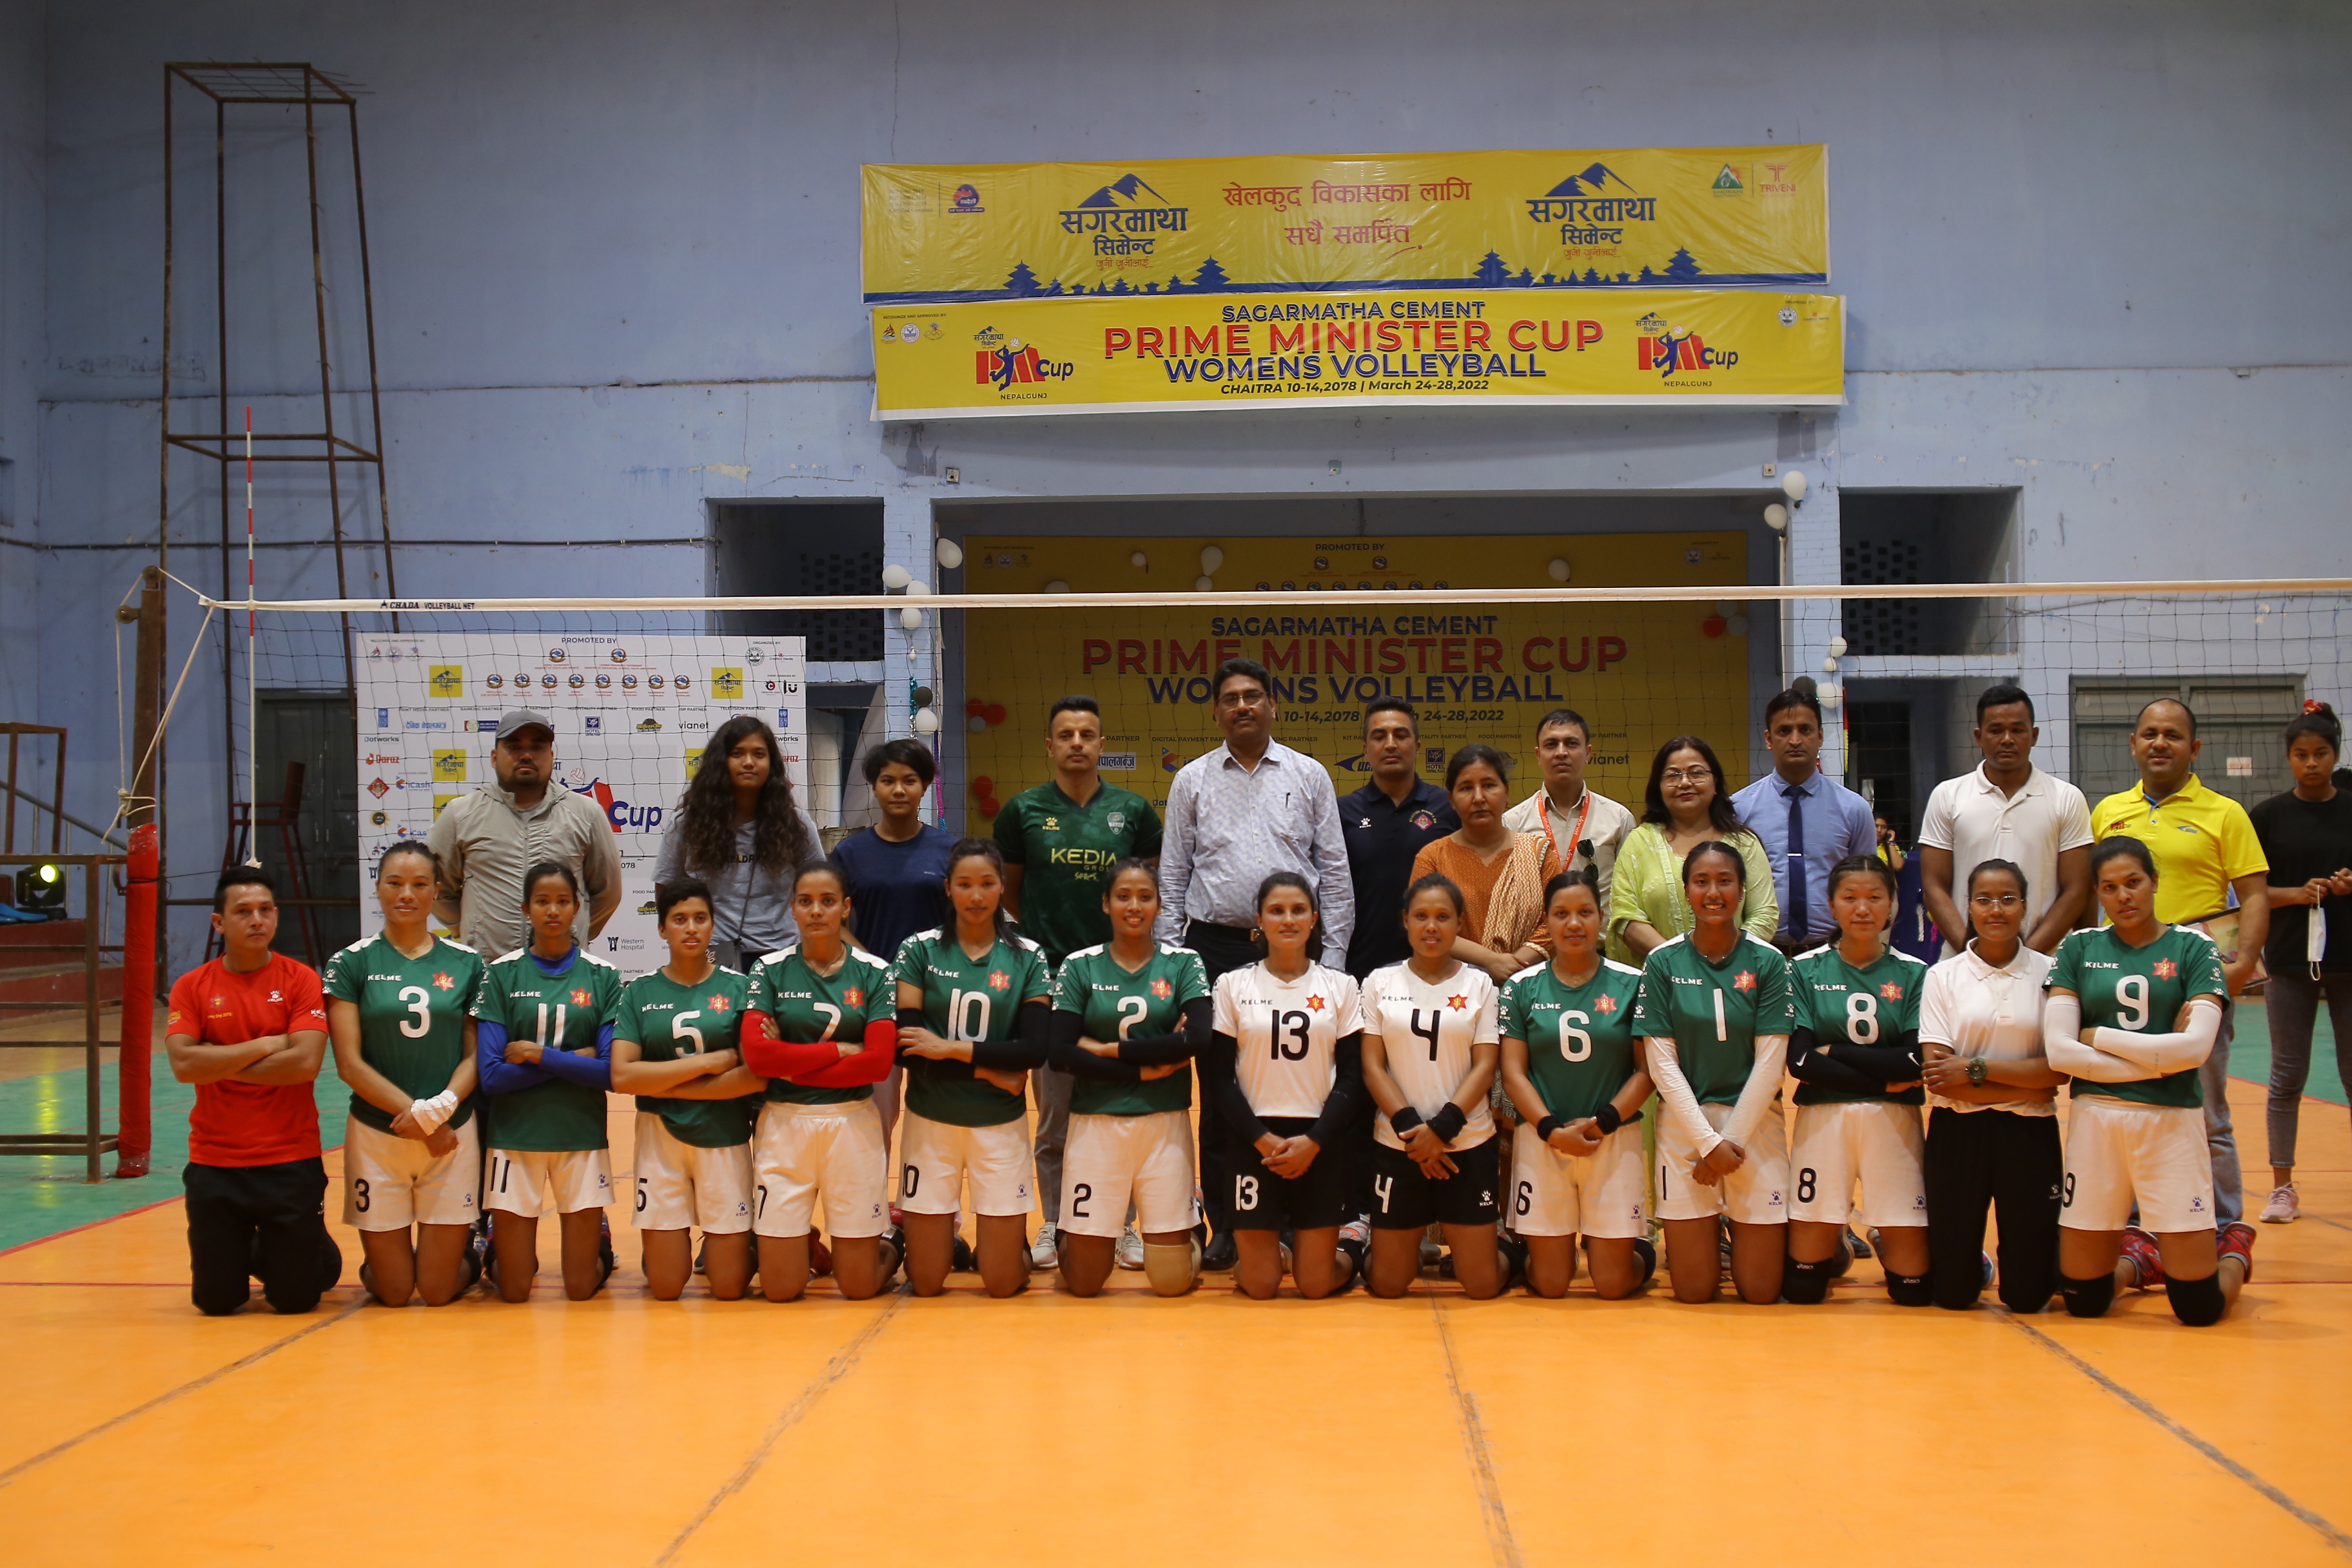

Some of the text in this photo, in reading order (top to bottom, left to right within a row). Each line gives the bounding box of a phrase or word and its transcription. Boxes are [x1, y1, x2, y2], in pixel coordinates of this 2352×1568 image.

[1222, 177, 1472, 211] खेलकुद विकासका लागि
[1526, 198, 1656, 222] सगरमाथा
[1059, 208, 1188, 233] सगरमाथा
[1332, 218, 1412, 244] समर्पित
[1561, 223, 1623, 244] सिमेन्ट
[1093, 233, 1155, 255] सिमेन्ट
[1222, 301, 1485, 322] SAGARMATHA CEMENT
[1104, 319, 1603, 359] PRIME MINISTER CUP
[1035, 359, 1073, 381] Cup
[1163, 353, 1547, 382] WOMENS VOLLEYBALL
[1700, 348, 1738, 370] Cup
[1220, 380, 1489, 395] CHAITRA 10-14,2078 March 24-28,2022
[1211, 615, 1498, 636] SAGARMATHA CEMENT
[1083, 636, 1627, 674] PRIME MINISTER CUP
[1146, 675, 1563, 703] WONS VOLLEYBALL
[678, 721, 709, 729] vianet
[1284, 711, 1359, 722] 10-14,2078
[1424, 710, 1504, 721] 24-28,2022
[1588, 753, 1629, 764] vianet
[609, 801, 662, 832] Cup
[1051, 848, 1117, 866] KEDIA
[927, 965, 959, 979] KELME
[398, 986, 430, 1038] 3
[642, 1003, 674, 1012] KELME
[947, 988, 991, 1043] 10
[1117, 995, 1148, 1041] 2
[1713, 988, 1727, 1041] 1
[1847, 992, 1879, 1044] 8
[2116, 974, 2149, 1031] 9
[536, 1003, 565, 1050] 11
[671, 1010, 703, 1059] 5
[812, 1002, 841, 1044] 7
[1271, 1010, 1310, 1061] 13
[1411, 1008, 1441, 1061] 4
[1559, 1010, 1592, 1063] 6
[490, 1157, 510, 1193] 11
[1798, 1168, 1817, 1203] 8
[354, 1179, 370, 1212] 3
[636, 1178, 648, 1212] 5
[757, 1185, 768, 1220] 7
[1073, 1183, 1092, 1217] 2
[1235, 1175, 1259, 1211] 13
[1375, 1174, 1393, 1213] 4
[1516, 1181, 1533, 1216] 6
